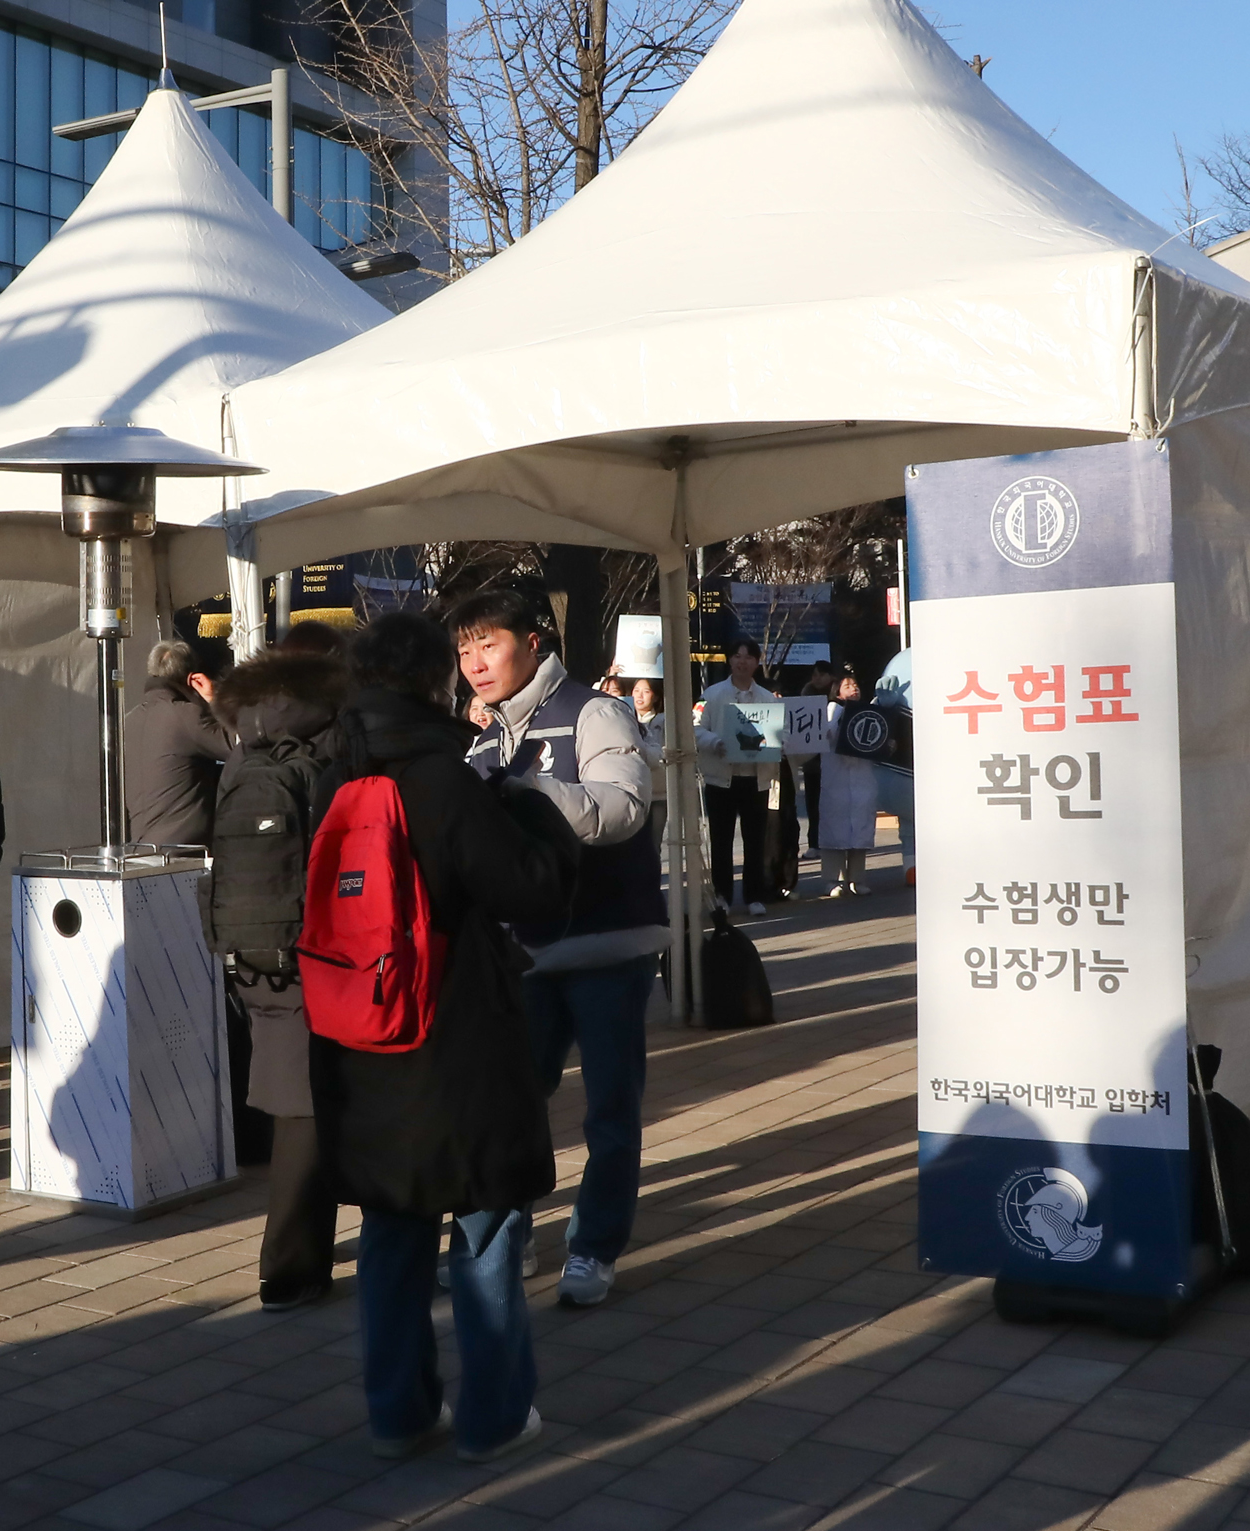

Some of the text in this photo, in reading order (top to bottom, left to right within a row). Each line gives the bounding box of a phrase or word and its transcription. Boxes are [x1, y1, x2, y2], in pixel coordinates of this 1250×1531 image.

[943, 664, 1139, 735] 수험표
[977, 752, 1103, 822] 확인
[962, 880, 1130, 927] 수험생만
[964, 946, 1130, 994] 입장가능
[930, 1077, 1171, 1116] 한국외국어대학교 입학처
